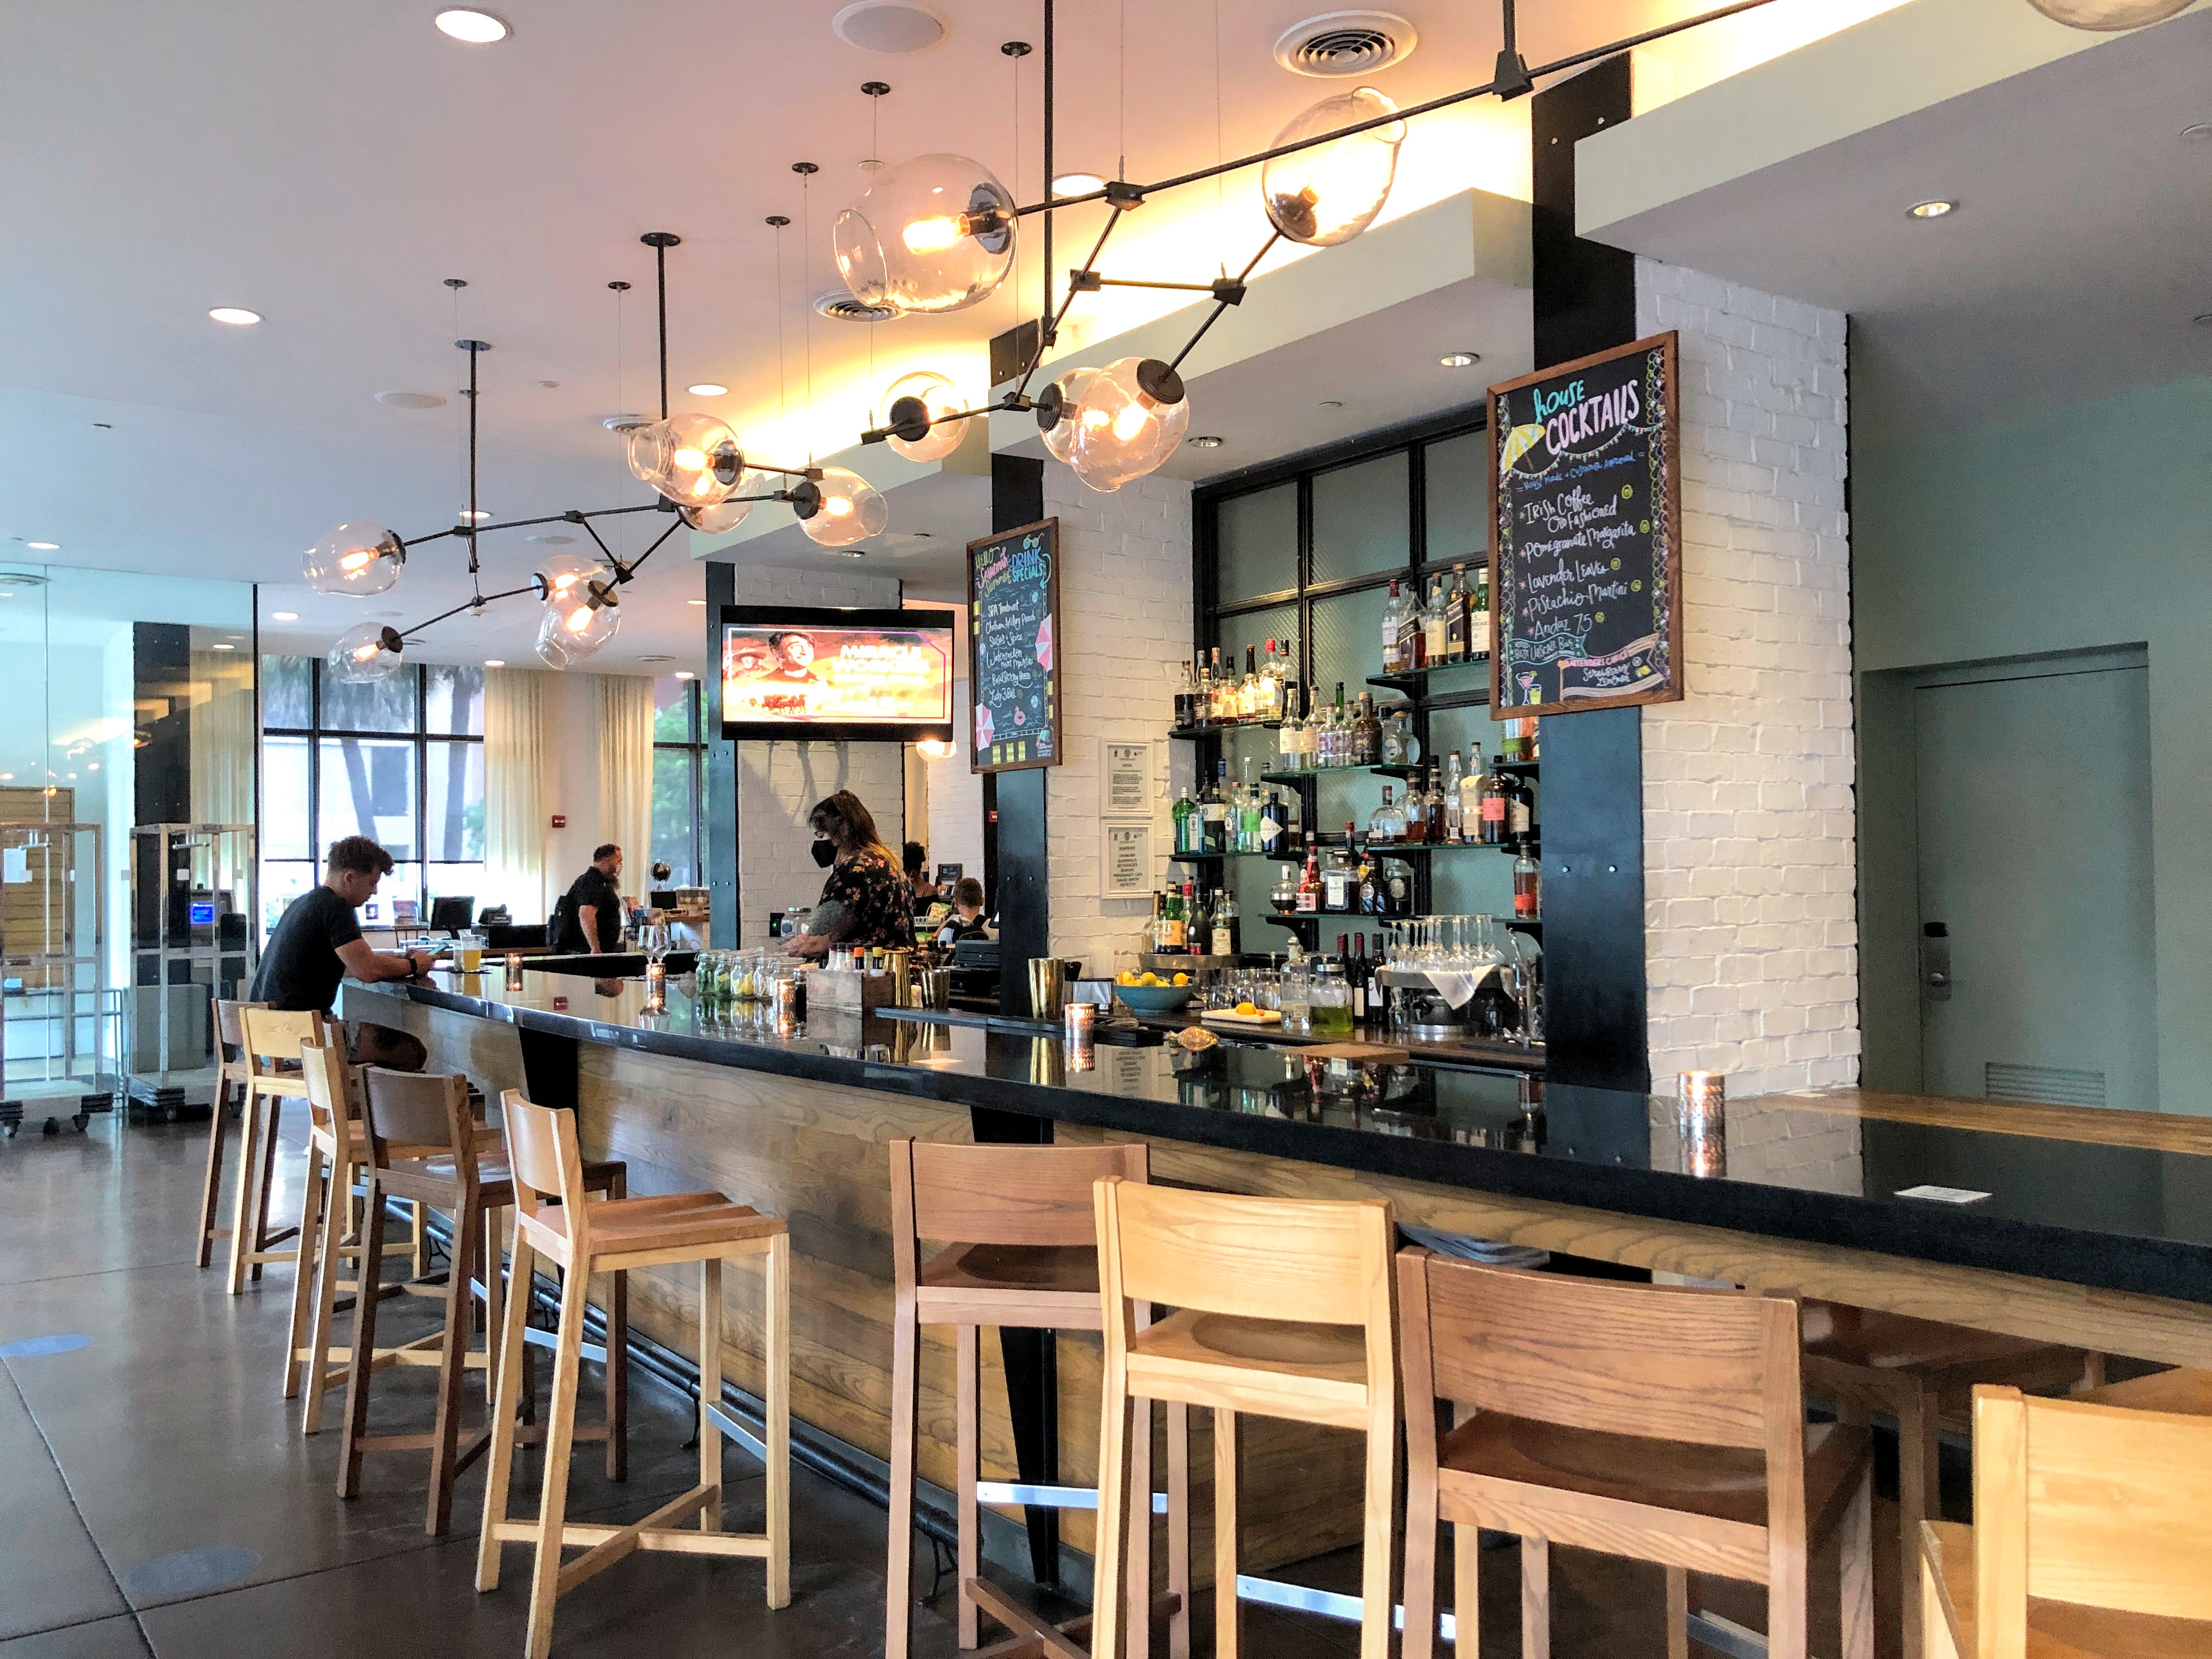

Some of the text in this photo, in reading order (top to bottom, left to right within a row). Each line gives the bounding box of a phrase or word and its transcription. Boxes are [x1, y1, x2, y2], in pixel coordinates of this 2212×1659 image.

[1533, 380, 1585, 425] house
[1546, 379, 1639, 455] COCKTAILS
[1558, 486, 1594, 516] Coffee
[1567, 494, 1617, 530] Fashioned
[1012, 545, 1043, 569] DRINK
[1525, 520, 1637, 563] Pomegranate Margarita
[1012, 563, 1043, 583] SPECIALS
[1527, 558, 1609, 594] Lavender Leaves
[1527, 580, 1628, 622] Pistachio Martini
[1534, 613, 1592, 640] Andaz 75
